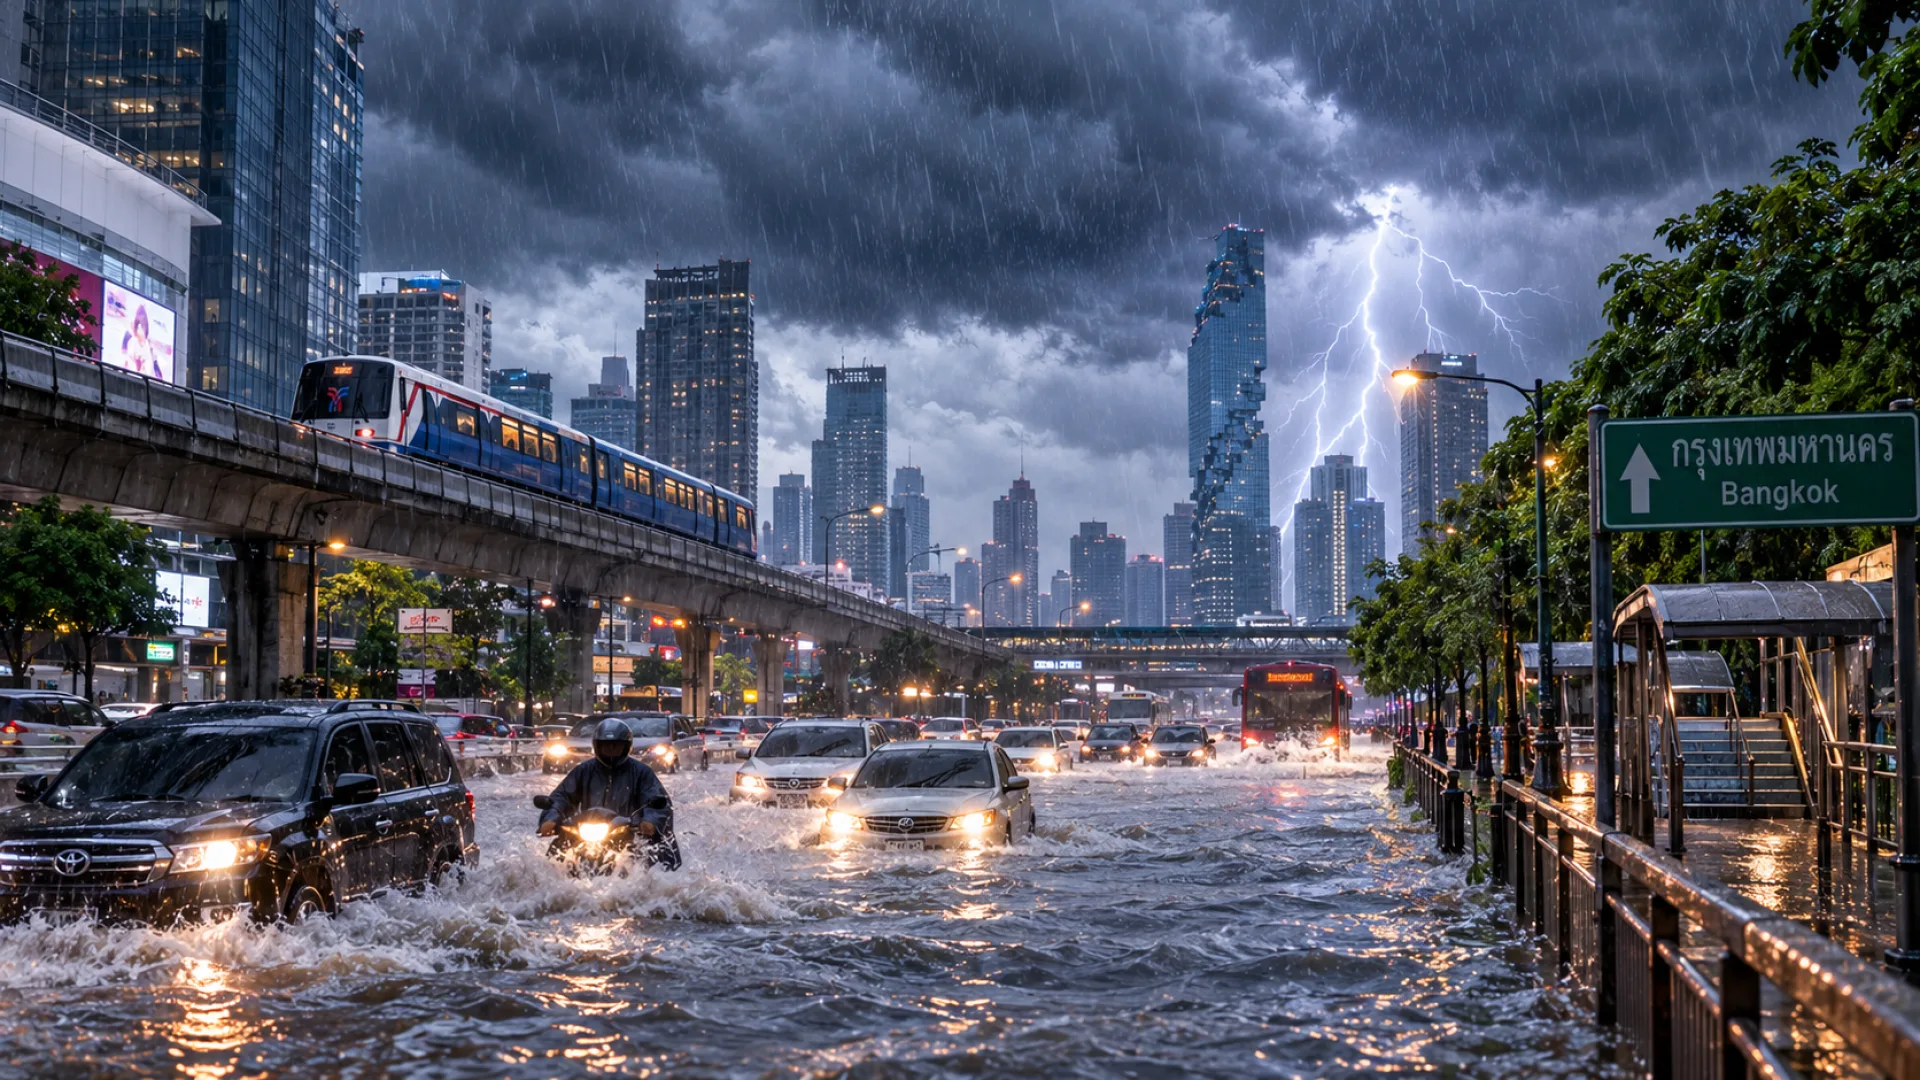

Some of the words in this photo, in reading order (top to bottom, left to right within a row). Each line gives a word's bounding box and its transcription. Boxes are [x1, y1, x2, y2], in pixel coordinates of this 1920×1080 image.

[1672, 432, 1893, 480] กรุงเทพมหานคร
[1721, 478, 1839, 510] Bangkok
